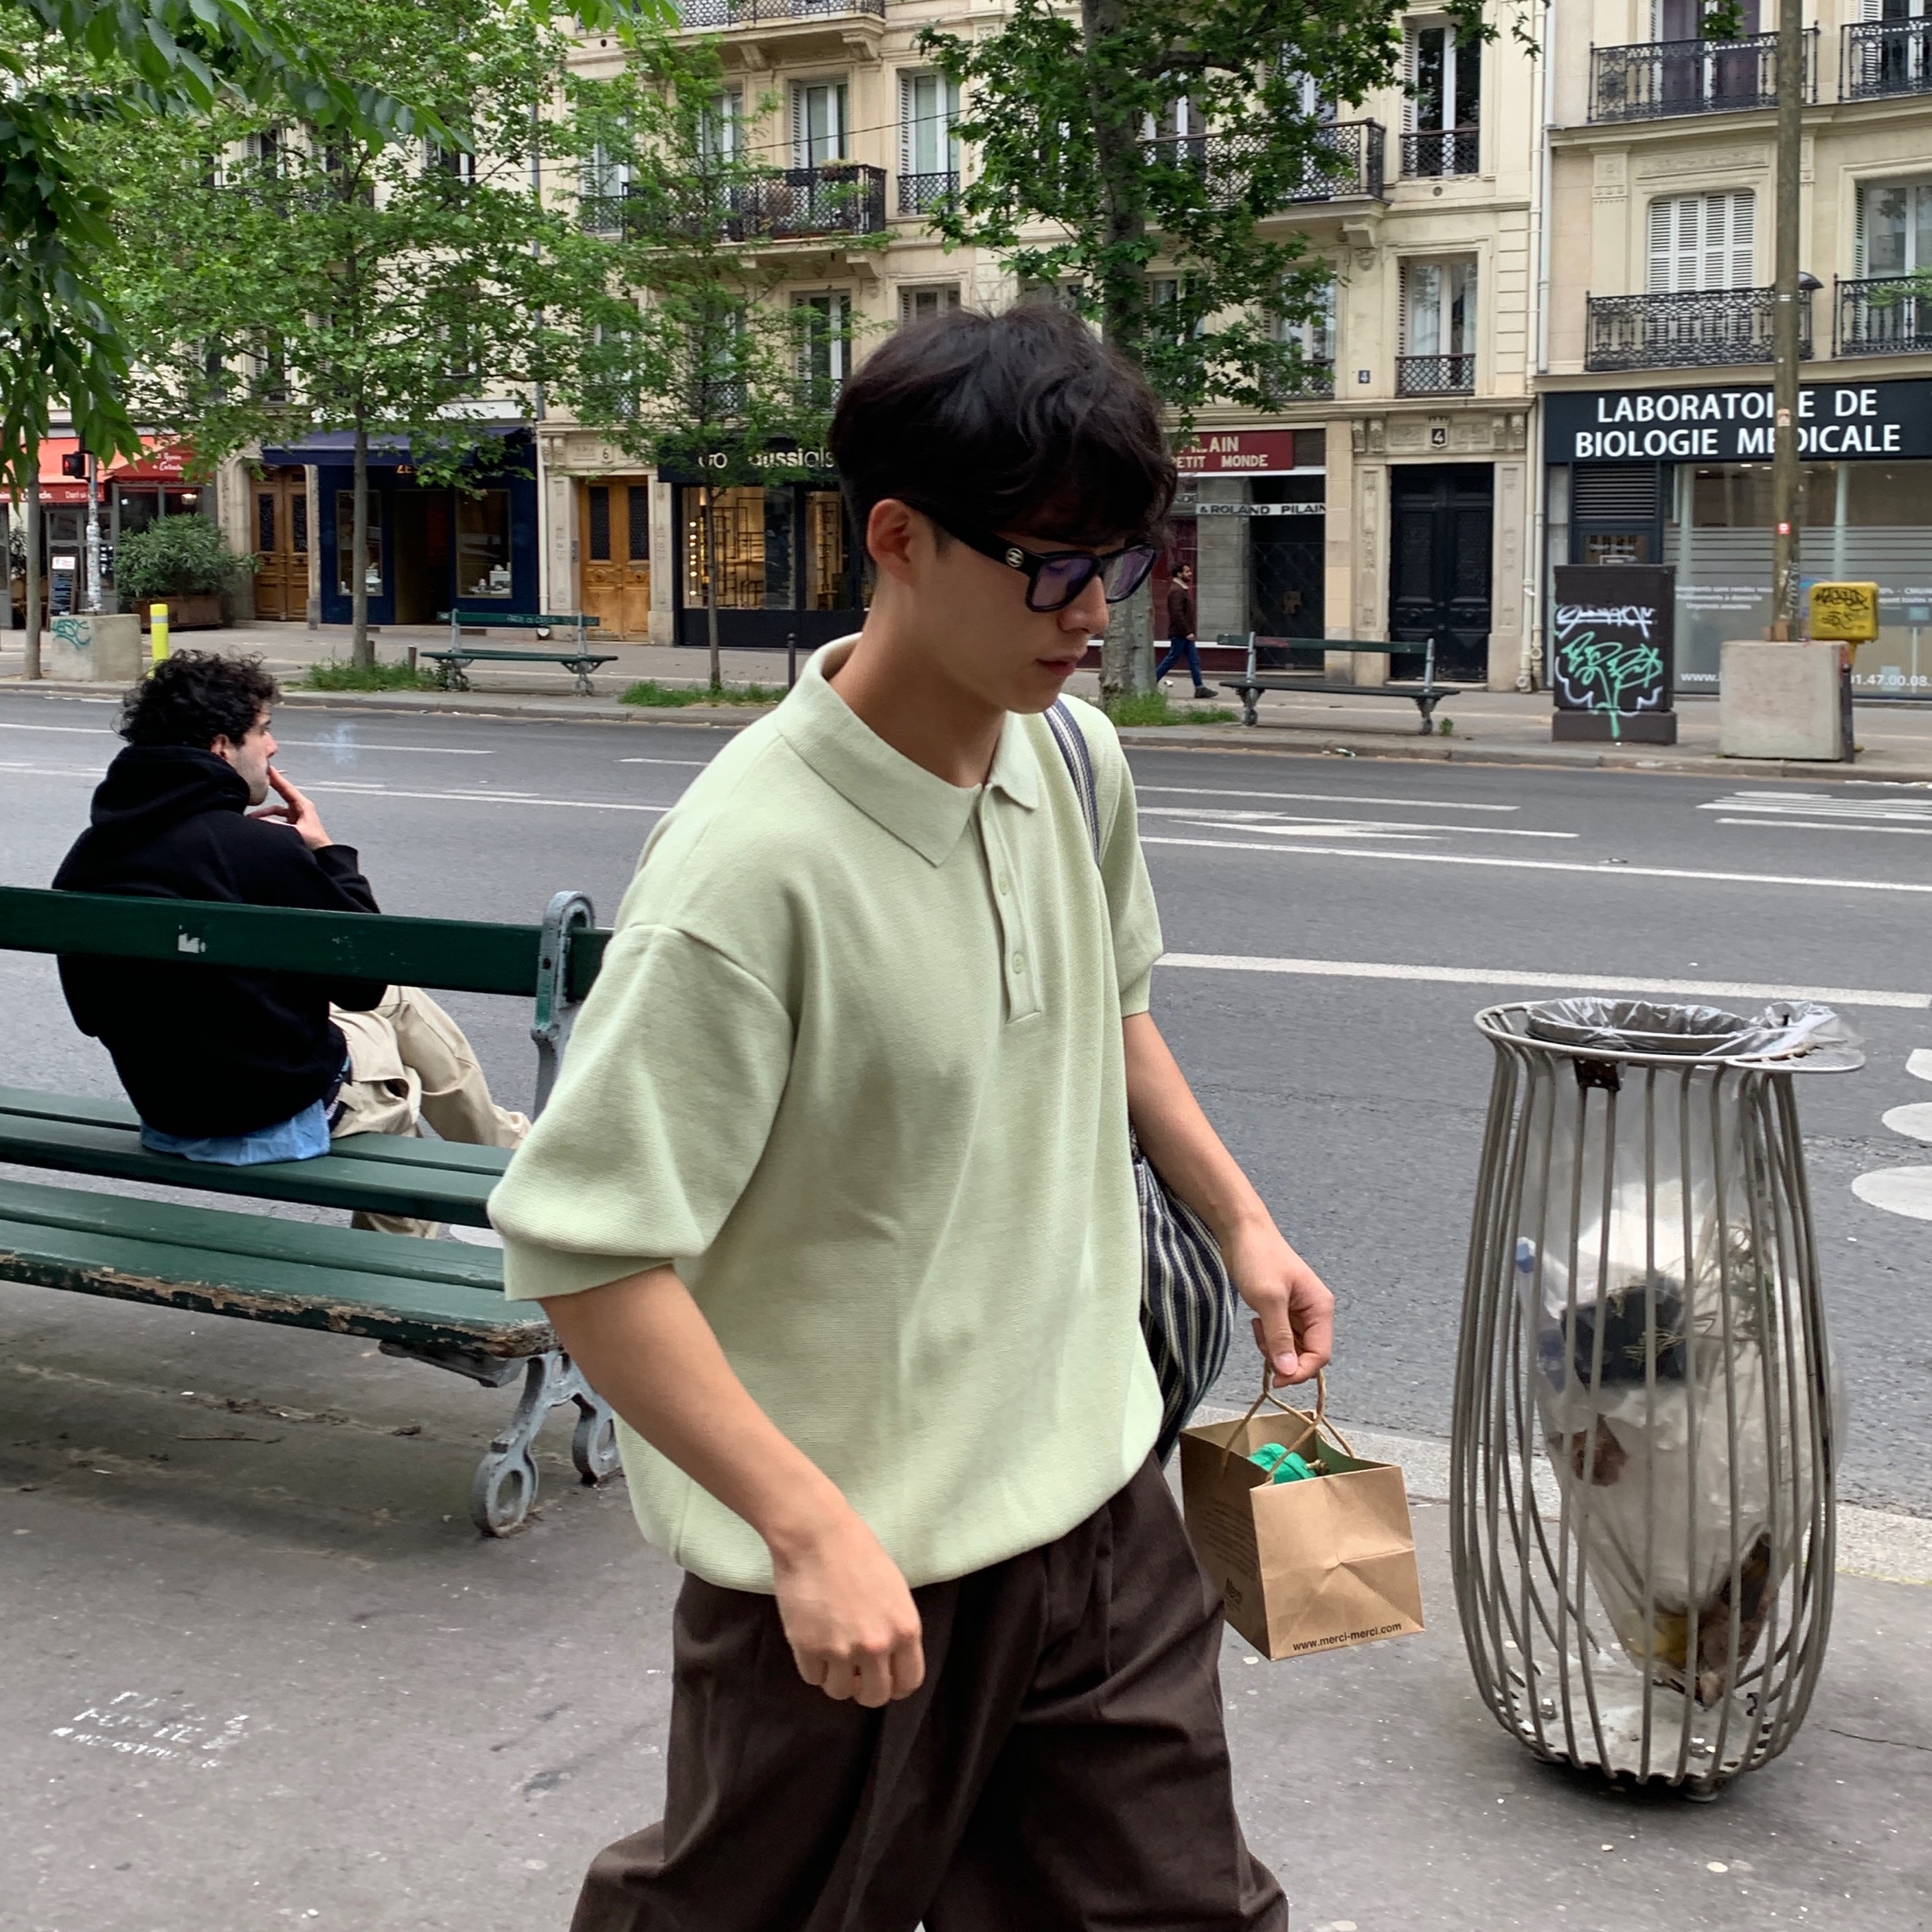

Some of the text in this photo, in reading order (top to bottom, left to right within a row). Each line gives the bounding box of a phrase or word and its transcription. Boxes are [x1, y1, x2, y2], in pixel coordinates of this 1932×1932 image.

[1597, 389, 1878, 423] LABORATOIE DE
[1433, 430, 1444, 443] 4
[1575, 428, 1719, 458] BIOLOGIE
[1179, 435, 1240, 453] LAIN
[602, 447, 609, 459] 6
[1220, 454, 1269, 468] MONDE
[1211, 505, 1271, 515] ROLAND
[1281, 504, 1327, 514] PILAIN
[1680, 672, 1722, 682] www.
[1851, 673, 1932, 687] 1.47.00.08.
[1292, 1622, 1402, 1651] www.merci-merci.com
